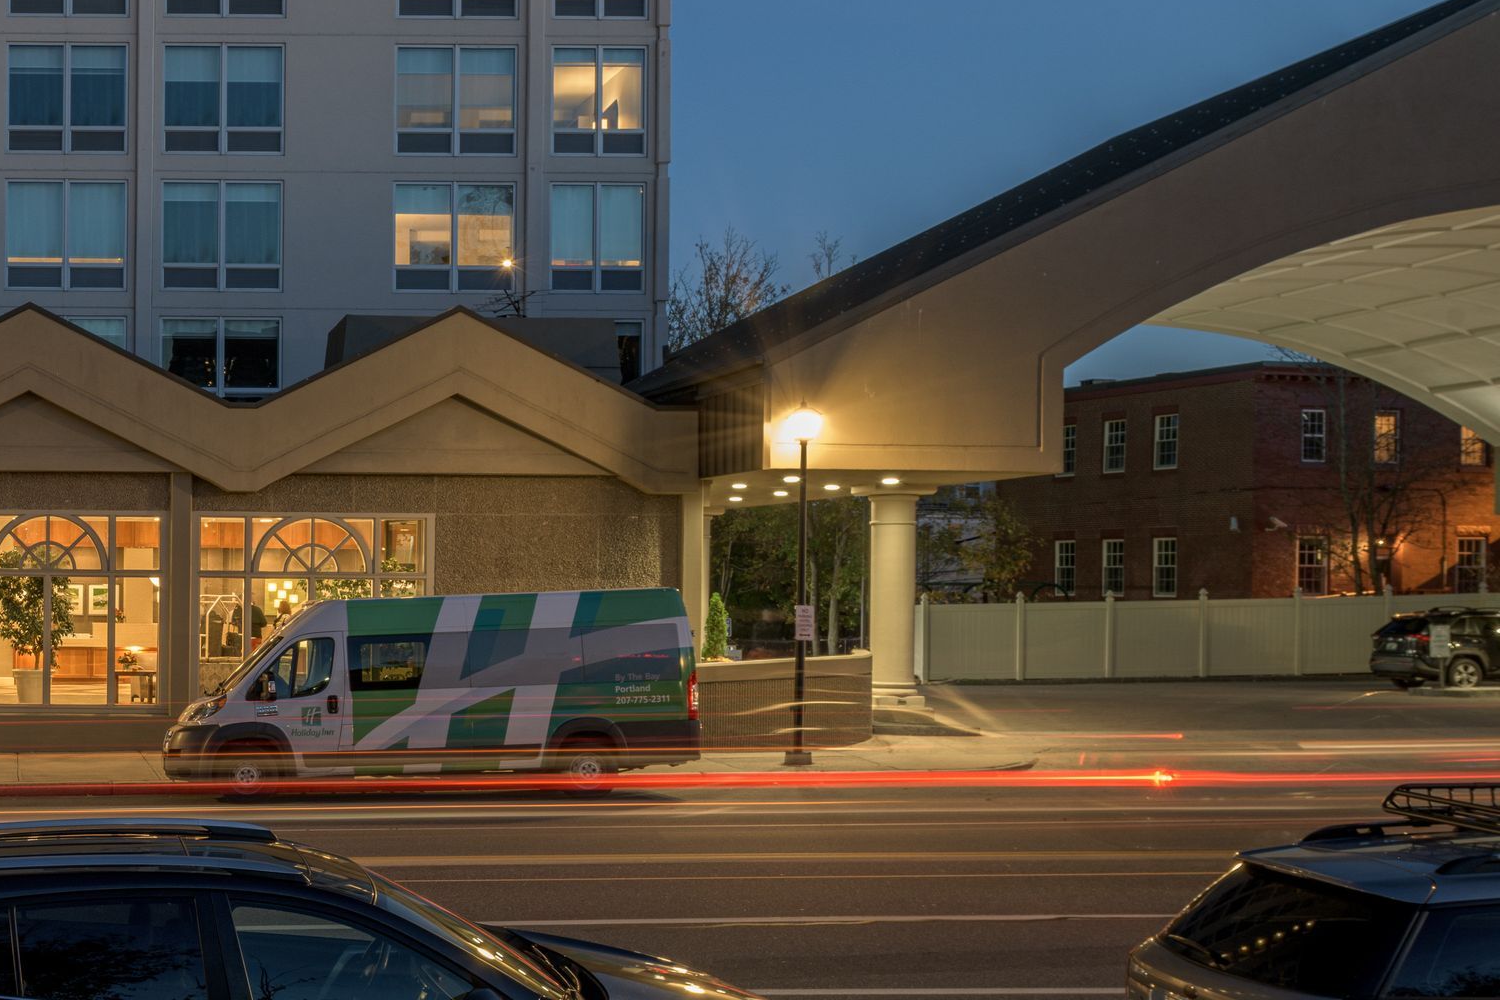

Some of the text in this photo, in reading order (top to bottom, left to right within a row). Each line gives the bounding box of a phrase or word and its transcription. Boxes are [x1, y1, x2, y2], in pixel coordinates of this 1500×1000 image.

[615, 673, 625, 682] By
[645, 673, 660, 681] Bay
[615, 684, 650, 693] Portland
[615, 695, 670, 704] 207-775-2311
[291, 728, 335, 738] Holiday Inn
